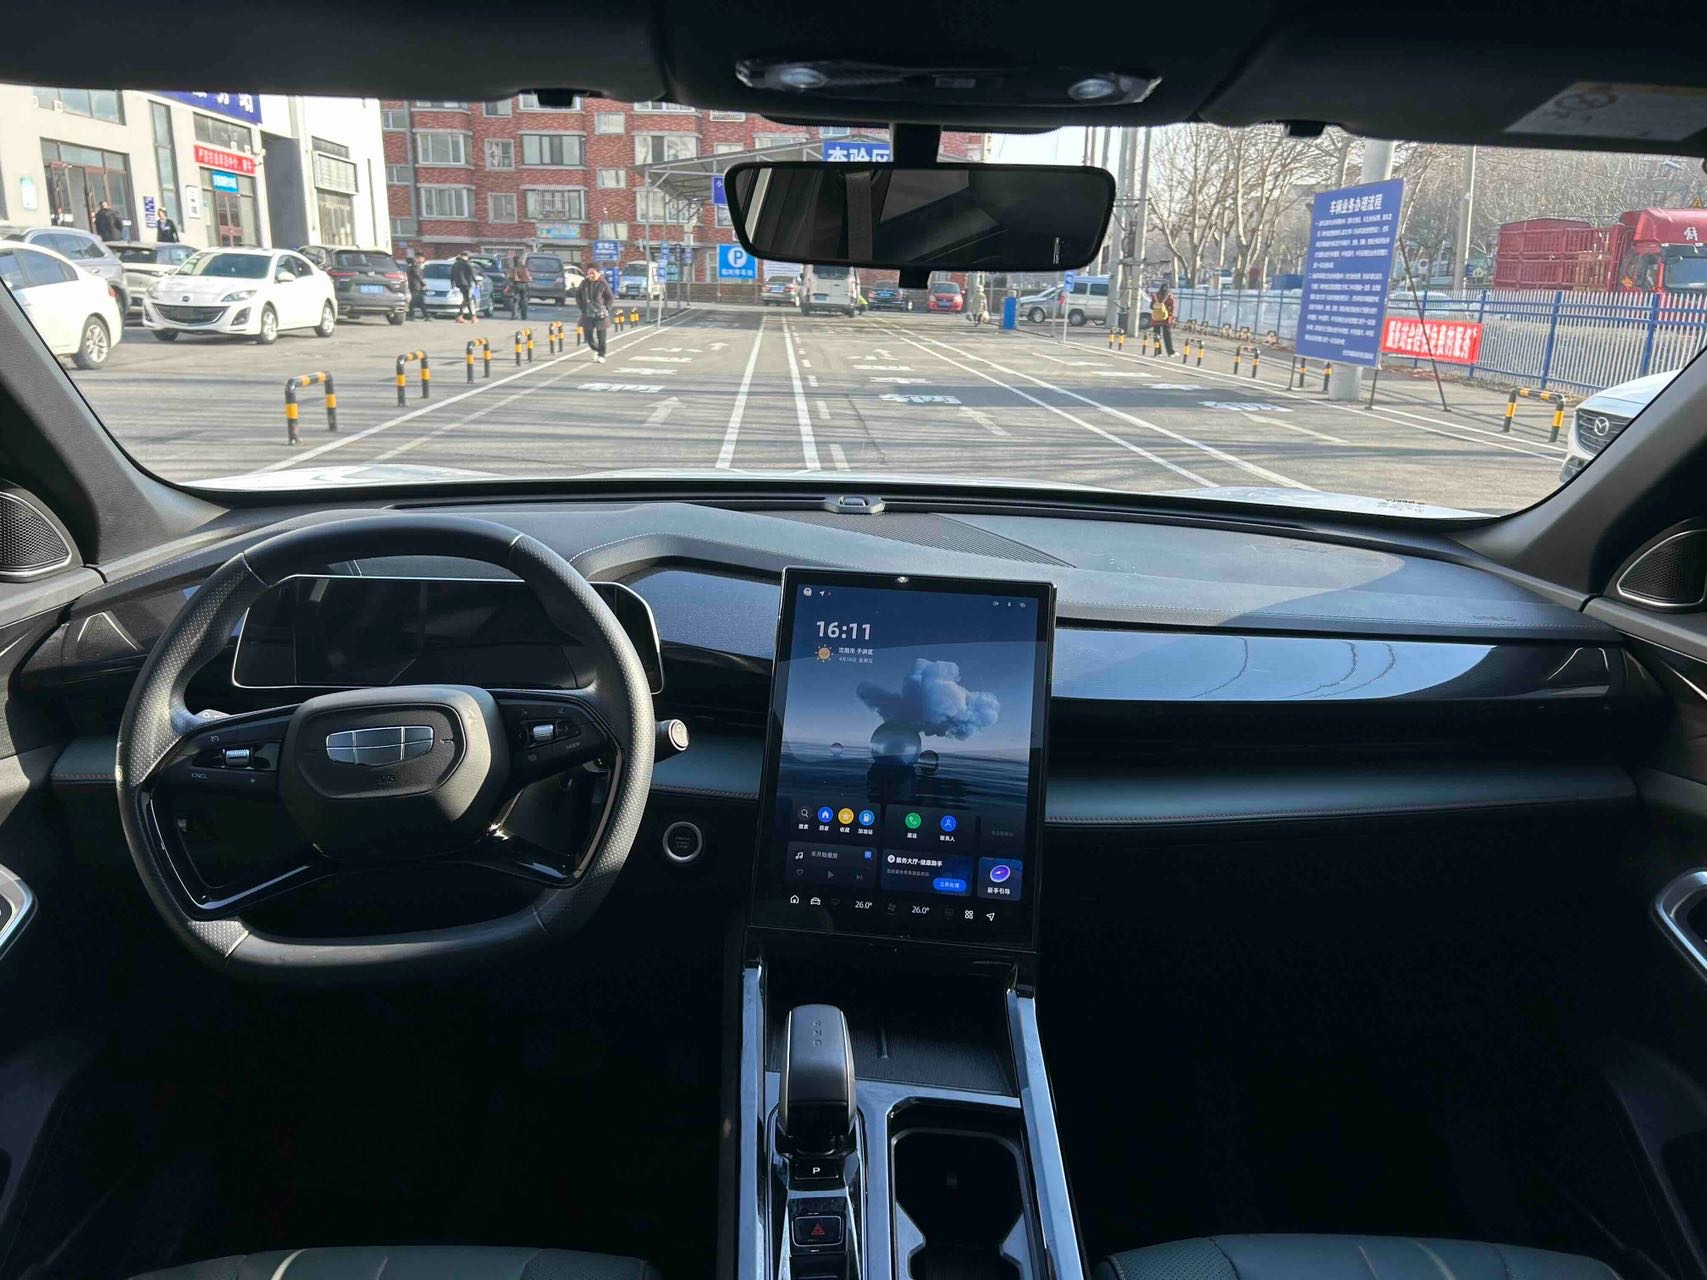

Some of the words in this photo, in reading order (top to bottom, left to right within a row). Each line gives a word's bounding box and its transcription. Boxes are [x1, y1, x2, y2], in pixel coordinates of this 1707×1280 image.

[1329, 194, 1383, 215] 车辆业务办理流程
[816, 621, 871, 640] 16:11
[857, 648, 873, 656] 于洪区
[987, 886, 1011, 895] 新手引导
[855, 901, 873, 910] 26.0°
[911, 906, 930, 915] 26.0°
[812, 1166, 821, 1174] P
